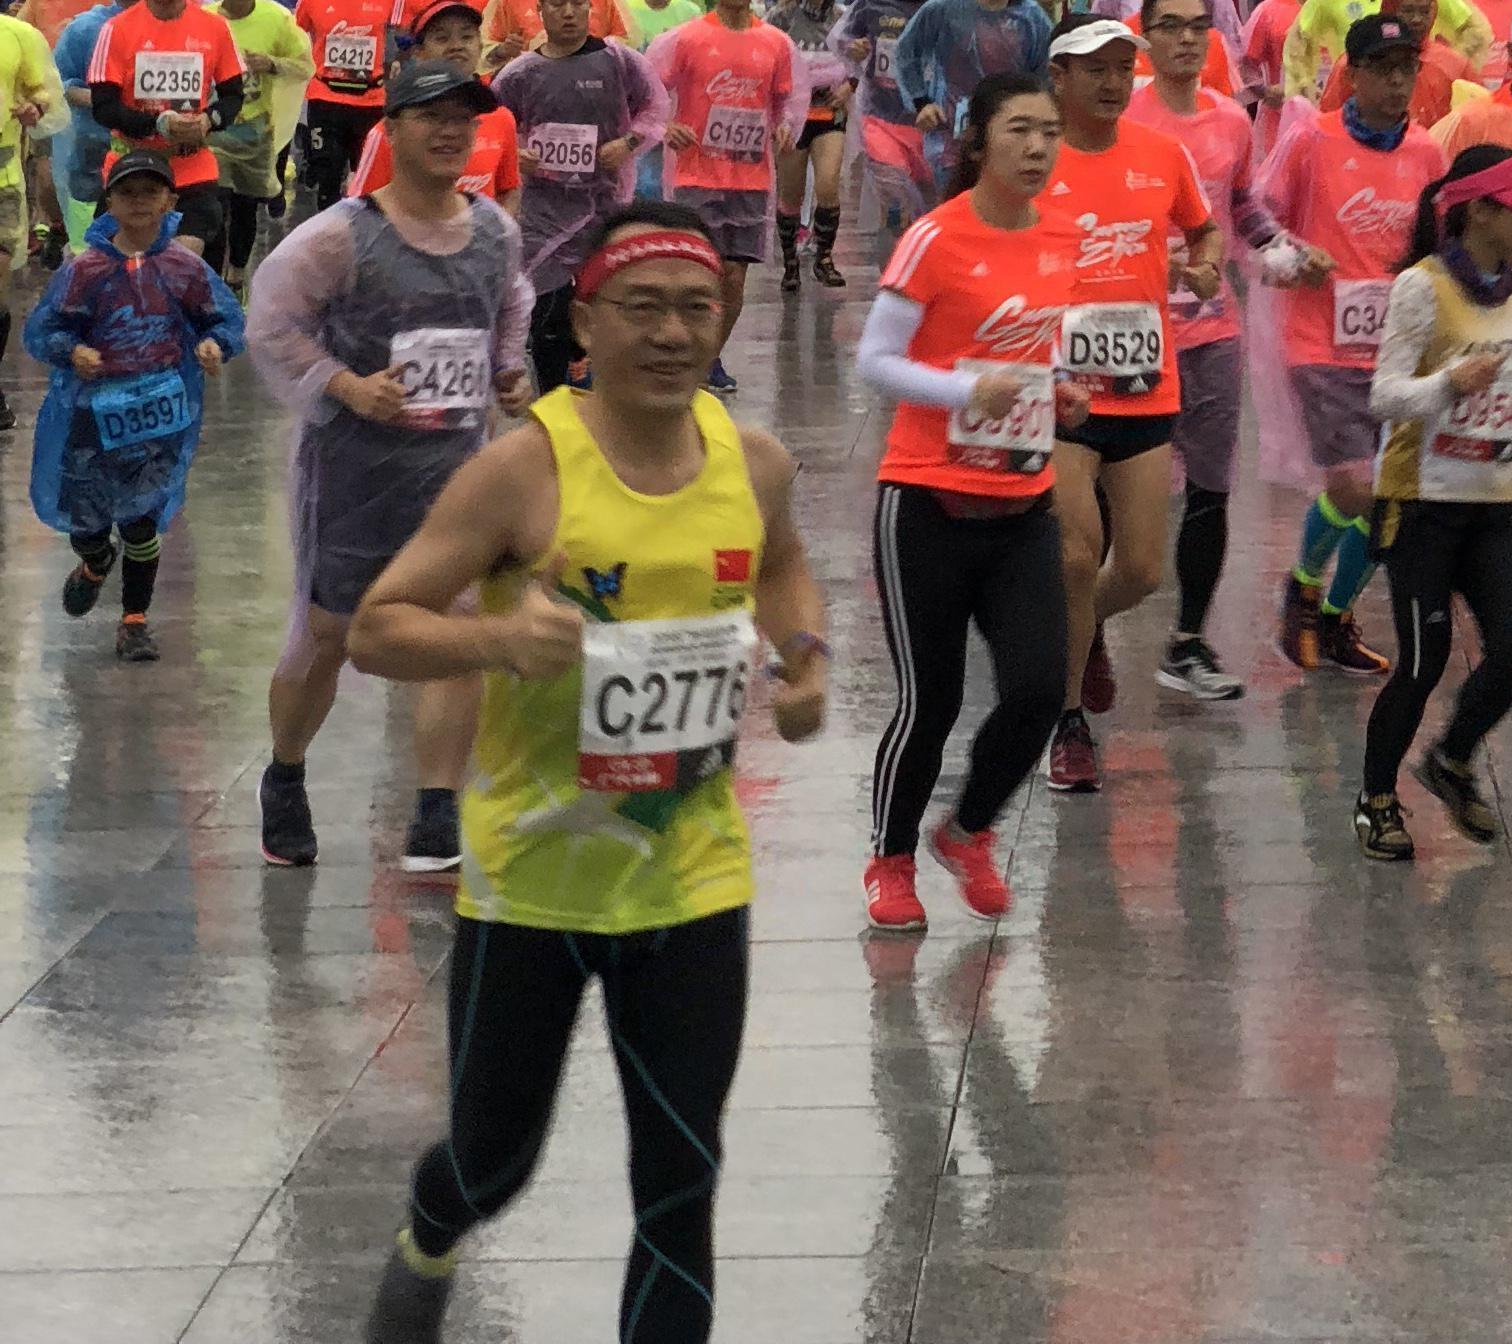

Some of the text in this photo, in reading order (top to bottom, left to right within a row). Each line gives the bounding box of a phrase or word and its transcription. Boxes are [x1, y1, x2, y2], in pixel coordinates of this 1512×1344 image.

[328, 47, 374, 66] C4212
[140, 70, 201, 93] C2356
[708, 121, 765, 145] C1572
[1069, 331, 1162, 366] D3529
[103, 392, 184, 440] D3597
